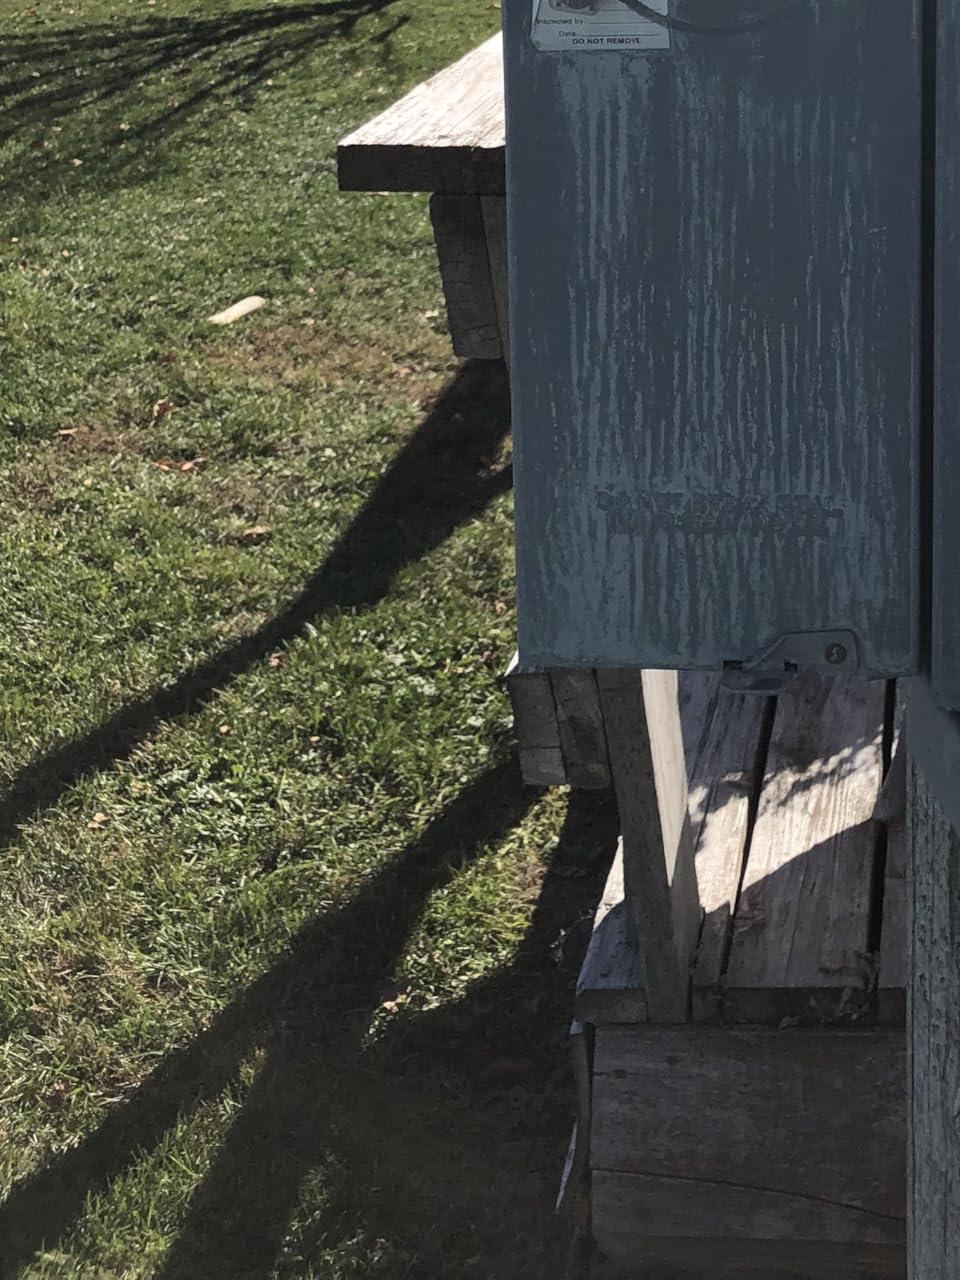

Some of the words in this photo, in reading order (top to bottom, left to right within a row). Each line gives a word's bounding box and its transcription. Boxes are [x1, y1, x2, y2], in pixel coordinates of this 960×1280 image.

[574, 18, 585, 26] by
[572, 37, 586, 45] DO
[587, 37, 604, 45] NOT
[606, 37, 641, 45] REMOVE
